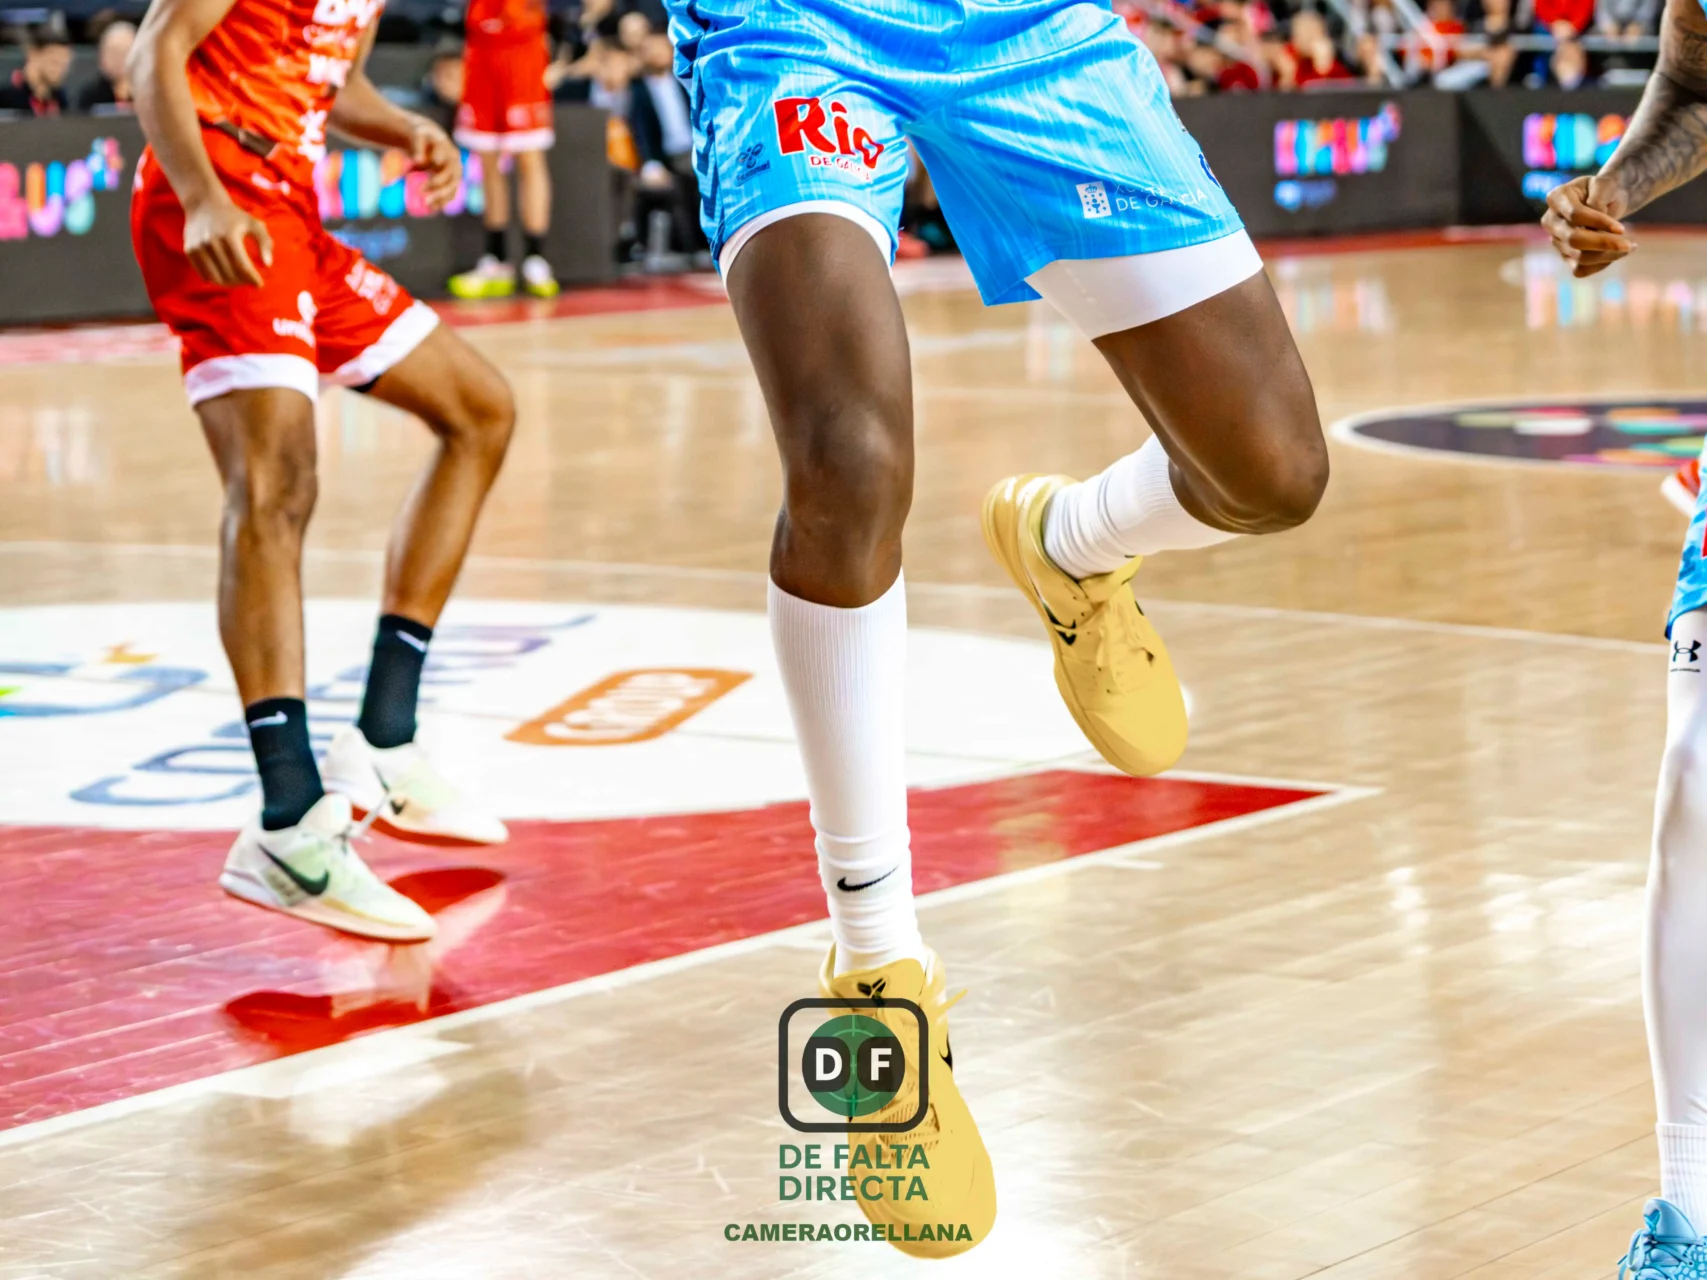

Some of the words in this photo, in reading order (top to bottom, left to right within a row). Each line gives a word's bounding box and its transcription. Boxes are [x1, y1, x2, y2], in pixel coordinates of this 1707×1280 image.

[774, 97, 885, 169] Rio
[810, 156, 832, 166] DE
[1115, 196, 1141, 212] DE
